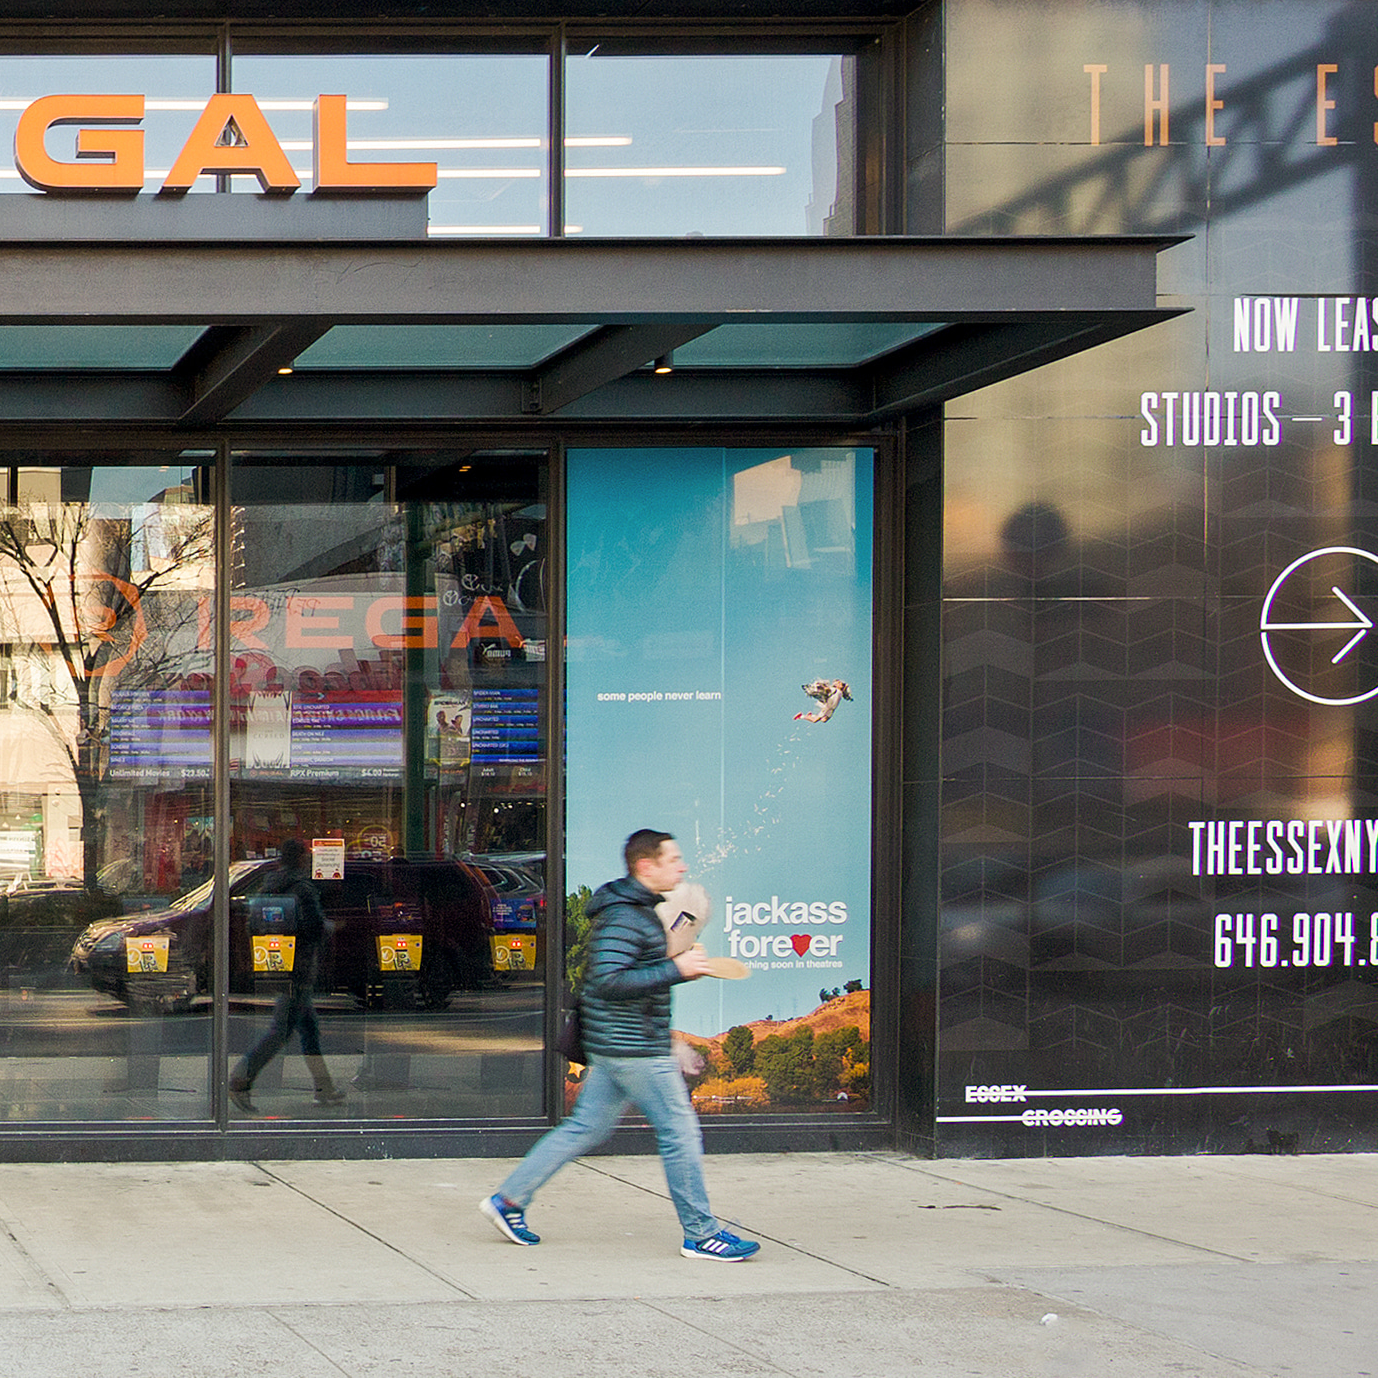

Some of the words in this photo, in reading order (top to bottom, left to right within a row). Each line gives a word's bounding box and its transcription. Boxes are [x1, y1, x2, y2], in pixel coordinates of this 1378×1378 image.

[1084, 64, 1227, 147] THE
[1317, 64, 1378, 147] E
[1233, 297, 1299, 352] NOW
[1141, 391, 1281, 446] STUDIOS
[1333, 391, 1352, 445] 3
[198, 595, 525, 649] REGA
[597, 692, 626, 701] some
[628, 691, 663, 703] people
[664, 692, 694, 701] never
[695, 690, 722, 700] learn
[723, 895, 848, 933] jackass
[771, 961, 794, 969] soon
[795, 960, 804, 968] in
[806, 960, 843, 969] theatres
[965, 1085, 1028, 1104] ESSEX
[1021, 1108, 1123, 1127] CROSSING
